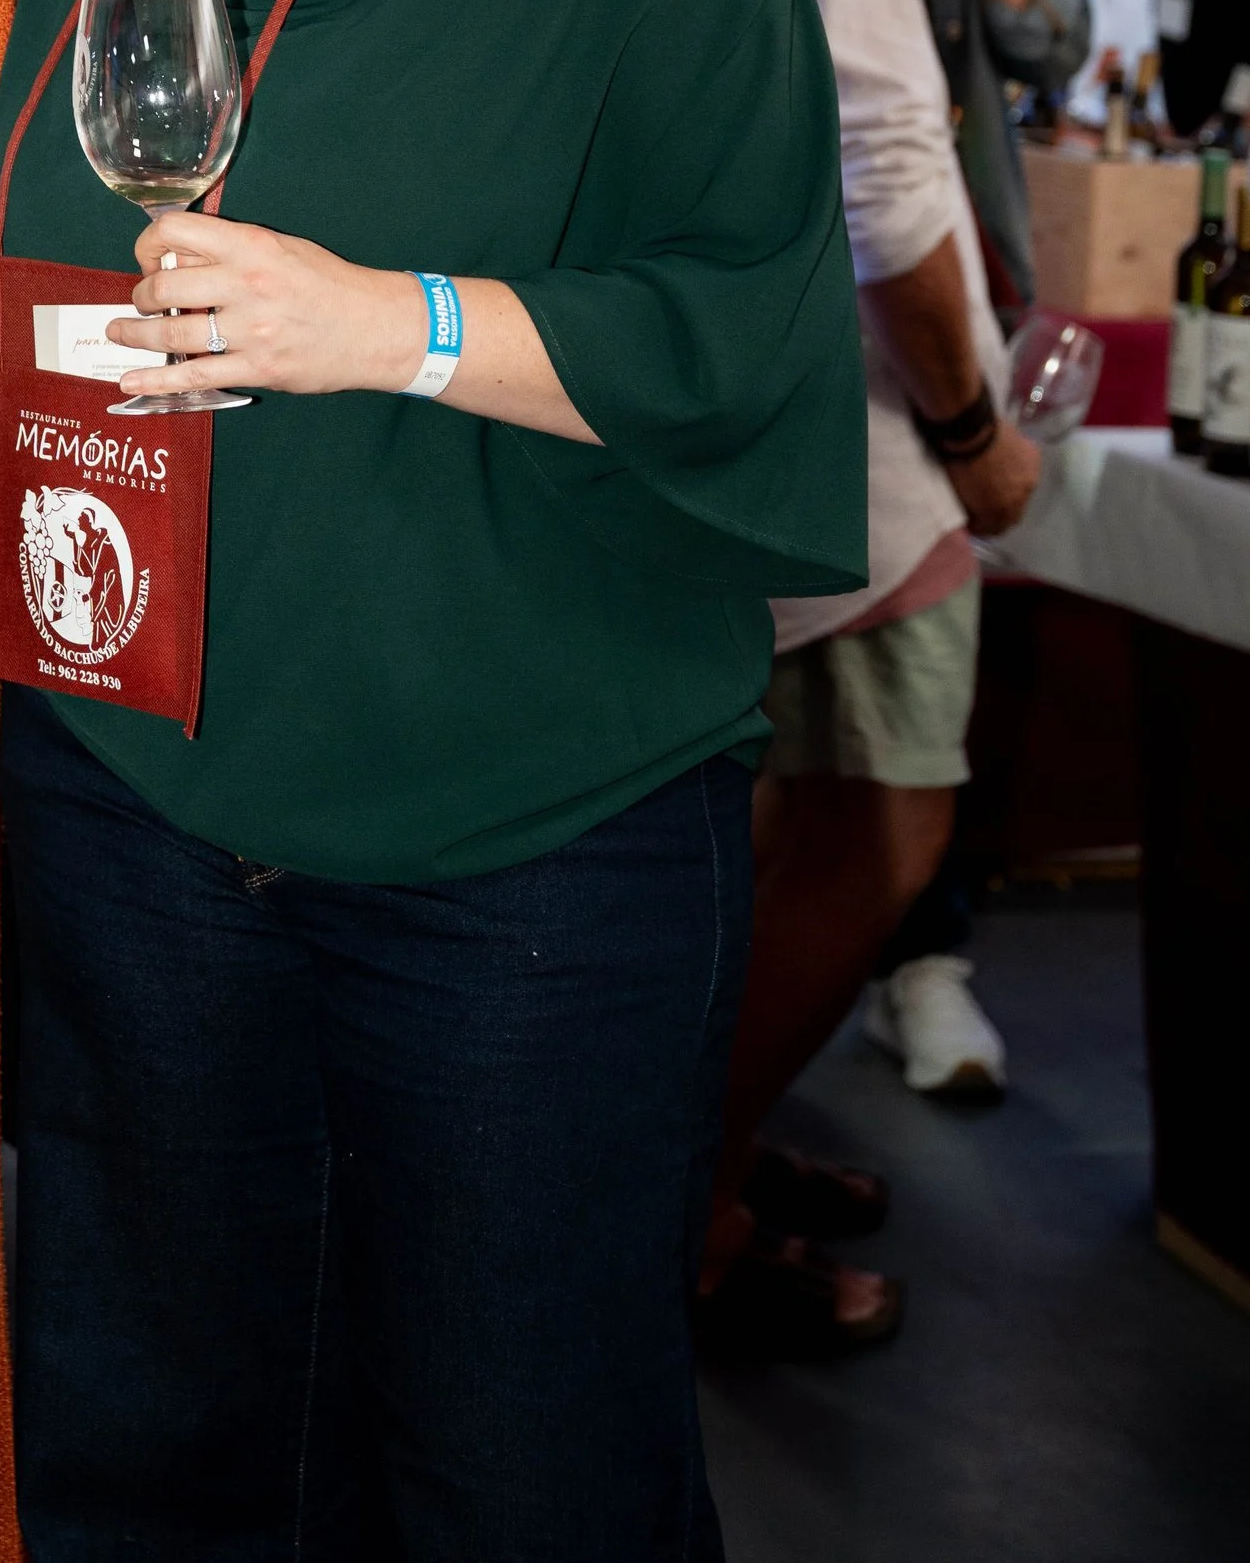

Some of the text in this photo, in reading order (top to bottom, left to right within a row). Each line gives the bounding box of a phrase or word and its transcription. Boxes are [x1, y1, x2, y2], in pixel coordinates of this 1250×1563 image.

[431, 287, 450, 347] VINHOS
[444, 286, 458, 347] GRANDE MOSTRA
[72, 338, 99, 354] para
[20, 409, 81, 429] RESTAURANTE
[82, 469, 166, 493] MEMORIES
[18, 542, 150, 665] CONFRARIA DO BACCHUS DE ALBUFEIRA
[37, 658, 122, 690] Tel: 962 228 930
